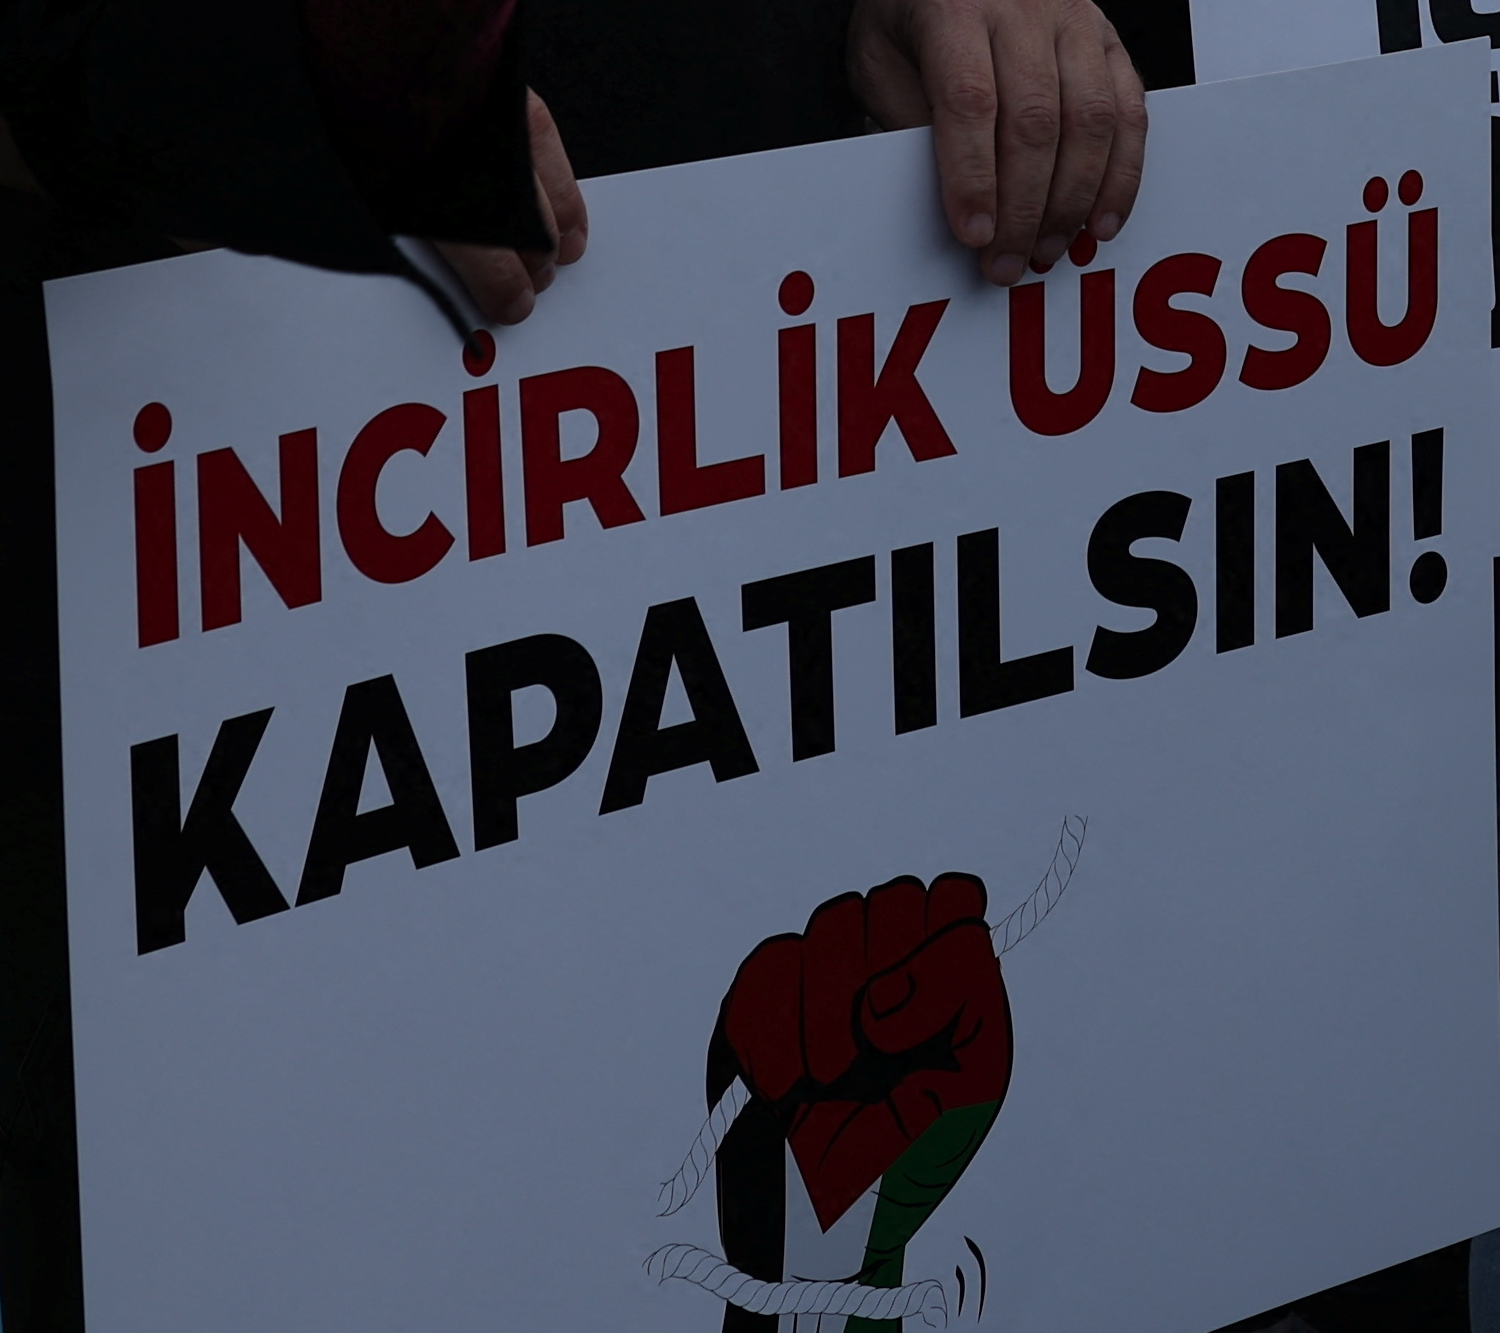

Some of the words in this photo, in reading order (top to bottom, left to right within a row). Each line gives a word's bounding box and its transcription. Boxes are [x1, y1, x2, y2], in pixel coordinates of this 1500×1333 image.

[133, 270, 958, 649] İNCİRLİK
[1009, 169, 1440, 437] ÜSSÜ
[129, 426, 1449, 957] KAPATILSIN!
